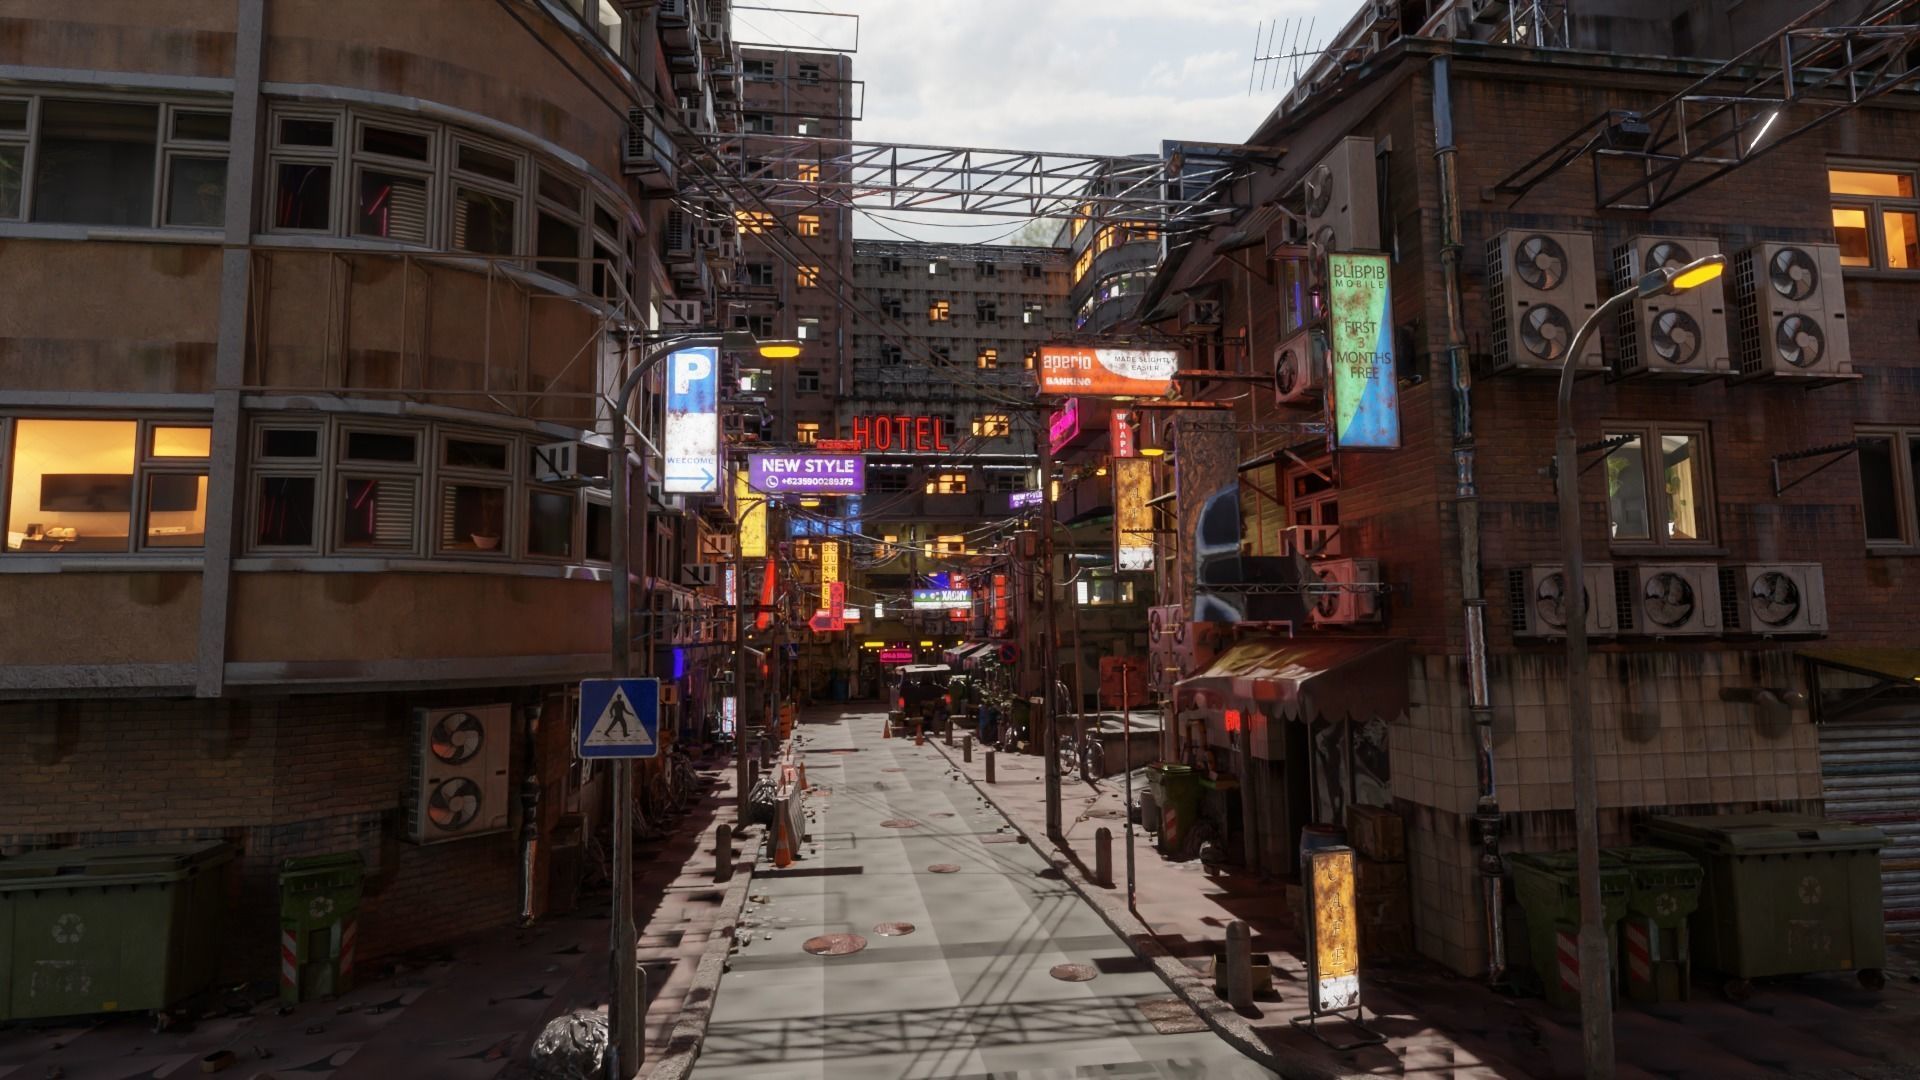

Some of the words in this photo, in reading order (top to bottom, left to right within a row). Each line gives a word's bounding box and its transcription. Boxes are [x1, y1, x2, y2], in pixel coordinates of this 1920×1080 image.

[1334, 264, 1385, 279] BLIBPIB
[1335, 280, 1384, 288] MOBILE
[1345, 322, 1376, 334] FIRST
[1358, 337, 1365, 348] 3
[1043, 352, 1091, 373] aperio
[1336, 351, 1391, 365] MONTHS
[674, 353, 711, 394] P
[1351, 367, 1379, 379] FREE
[1046, 377, 1091, 386] BANKING
[853, 416, 949, 450] HOTEL
[763, 459, 800, 472] NEW
[805, 459, 854, 473] STYLE
